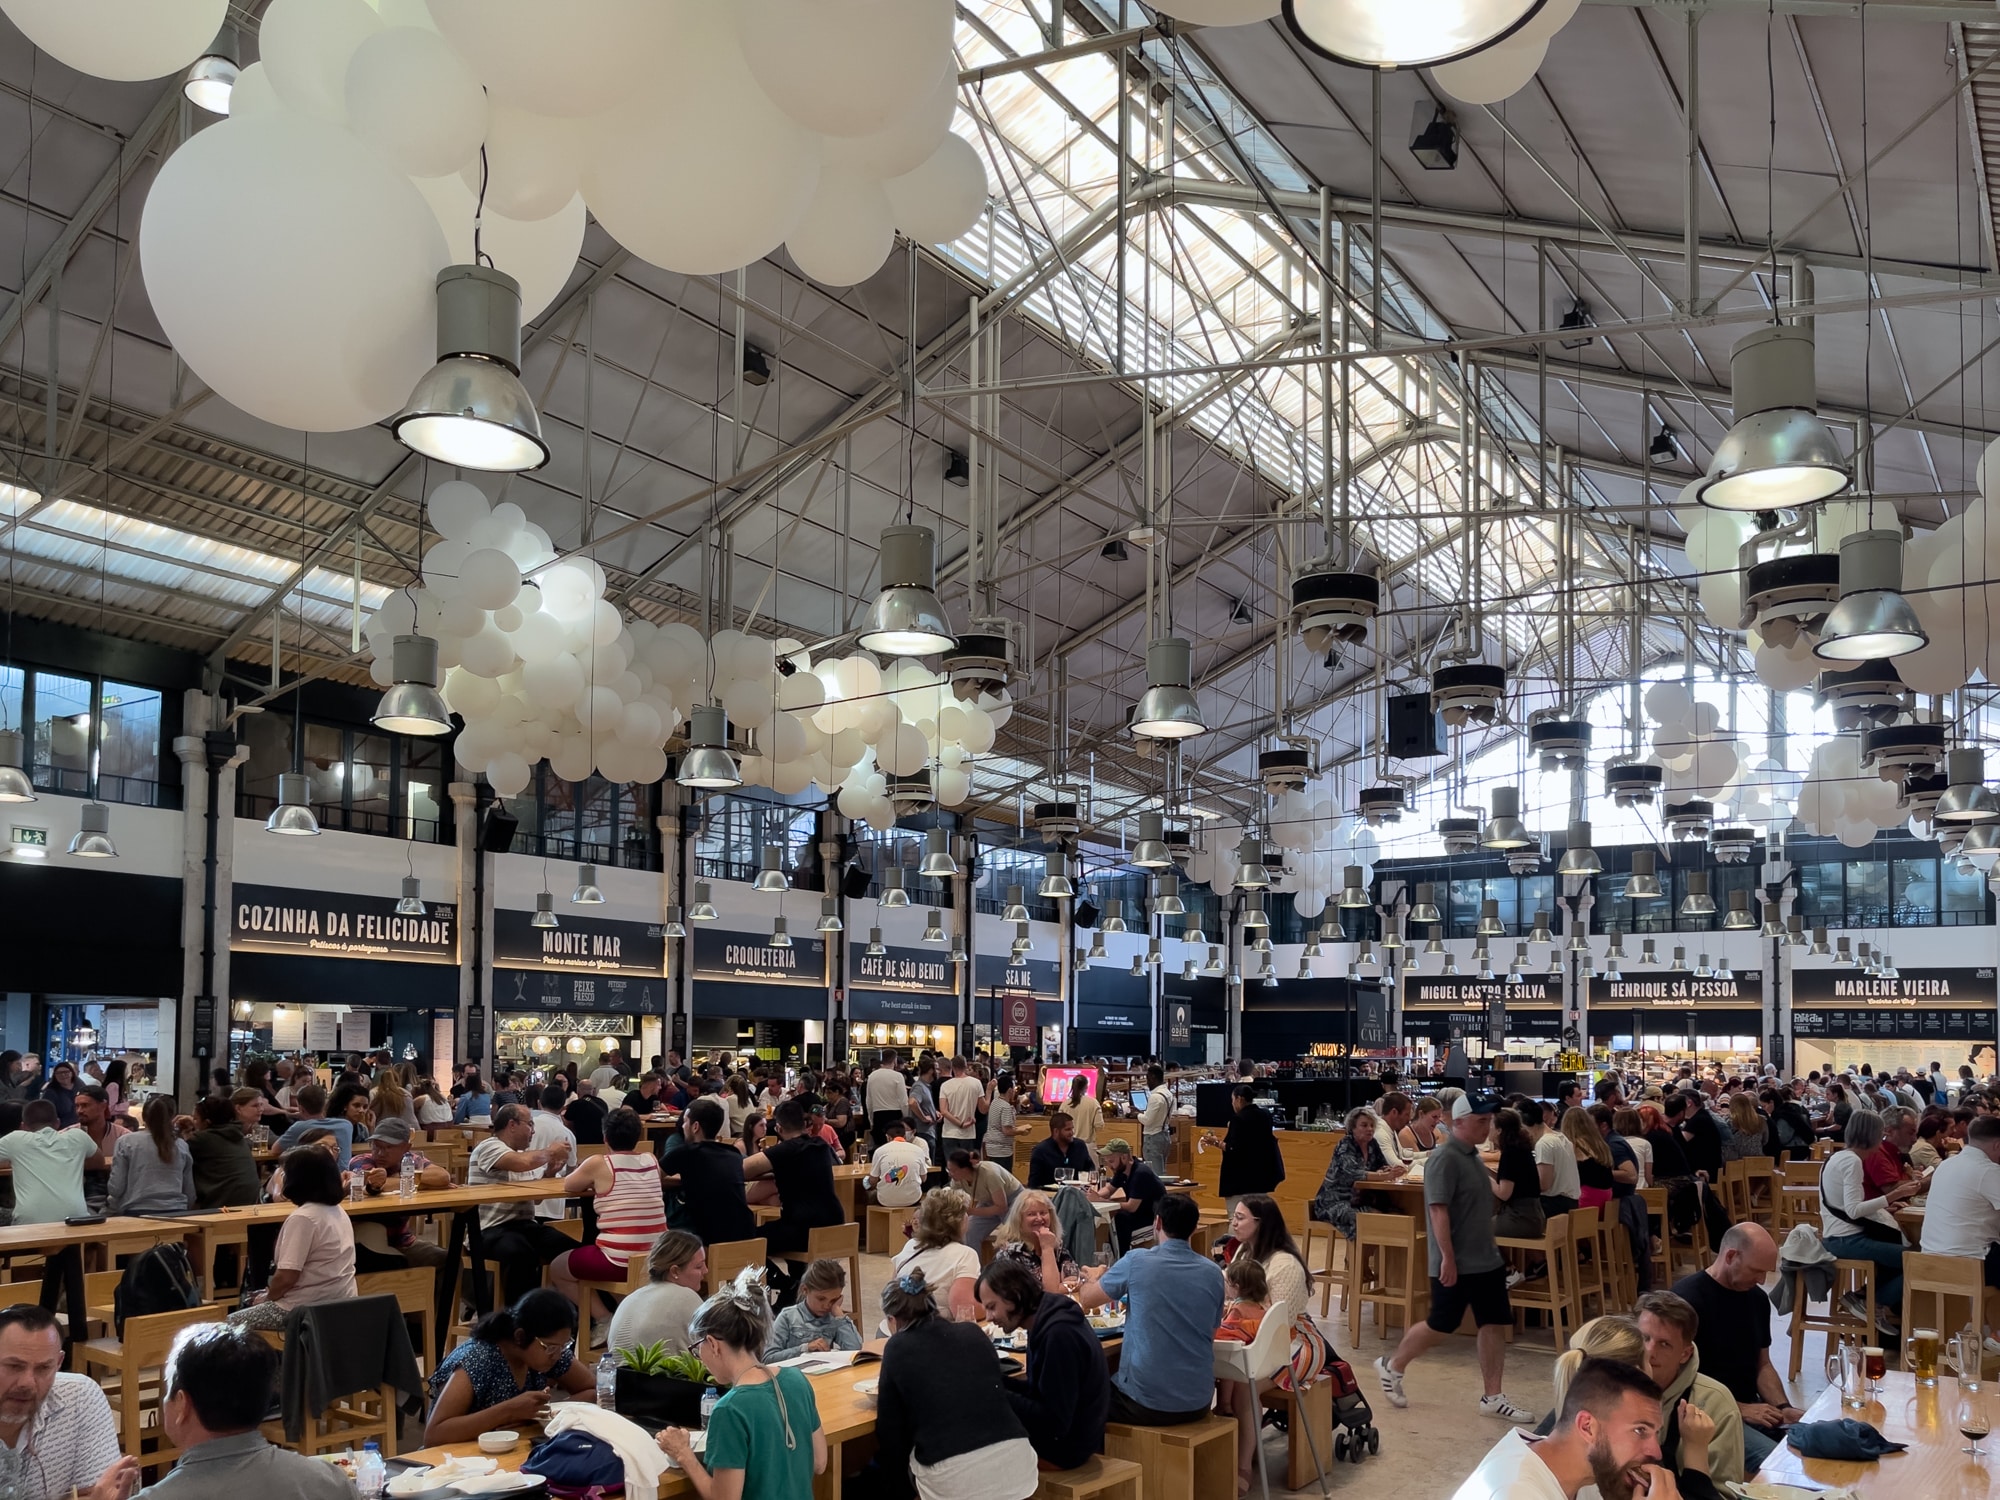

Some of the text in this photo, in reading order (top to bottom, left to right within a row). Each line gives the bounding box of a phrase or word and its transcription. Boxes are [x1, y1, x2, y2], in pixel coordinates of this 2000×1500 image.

[239, 904, 450, 945] COZINHA DA FELICIDADE
[309, 938, 341, 949] Petiscos
[542, 930, 621, 957] MONTE MAR
[725, 945, 796, 968] CROQUETERIA
[861, 956, 945, 981] CAFÉ DE SÃO BENTO
[573, 980, 595, 992] PEIXE
[1005, 969, 1031, 987] SEA ME
[1420, 984, 1546, 1000] MIGUEL CASTRO E SILVA
[1610, 979, 1739, 998] HENRIQUE SÁ PESSOA
[1835, 979, 1950, 996] MARLENE VIEIRA
[573, 992, 595, 1002] FRESCO
[1009, 1027, 1031, 1037] BEER
